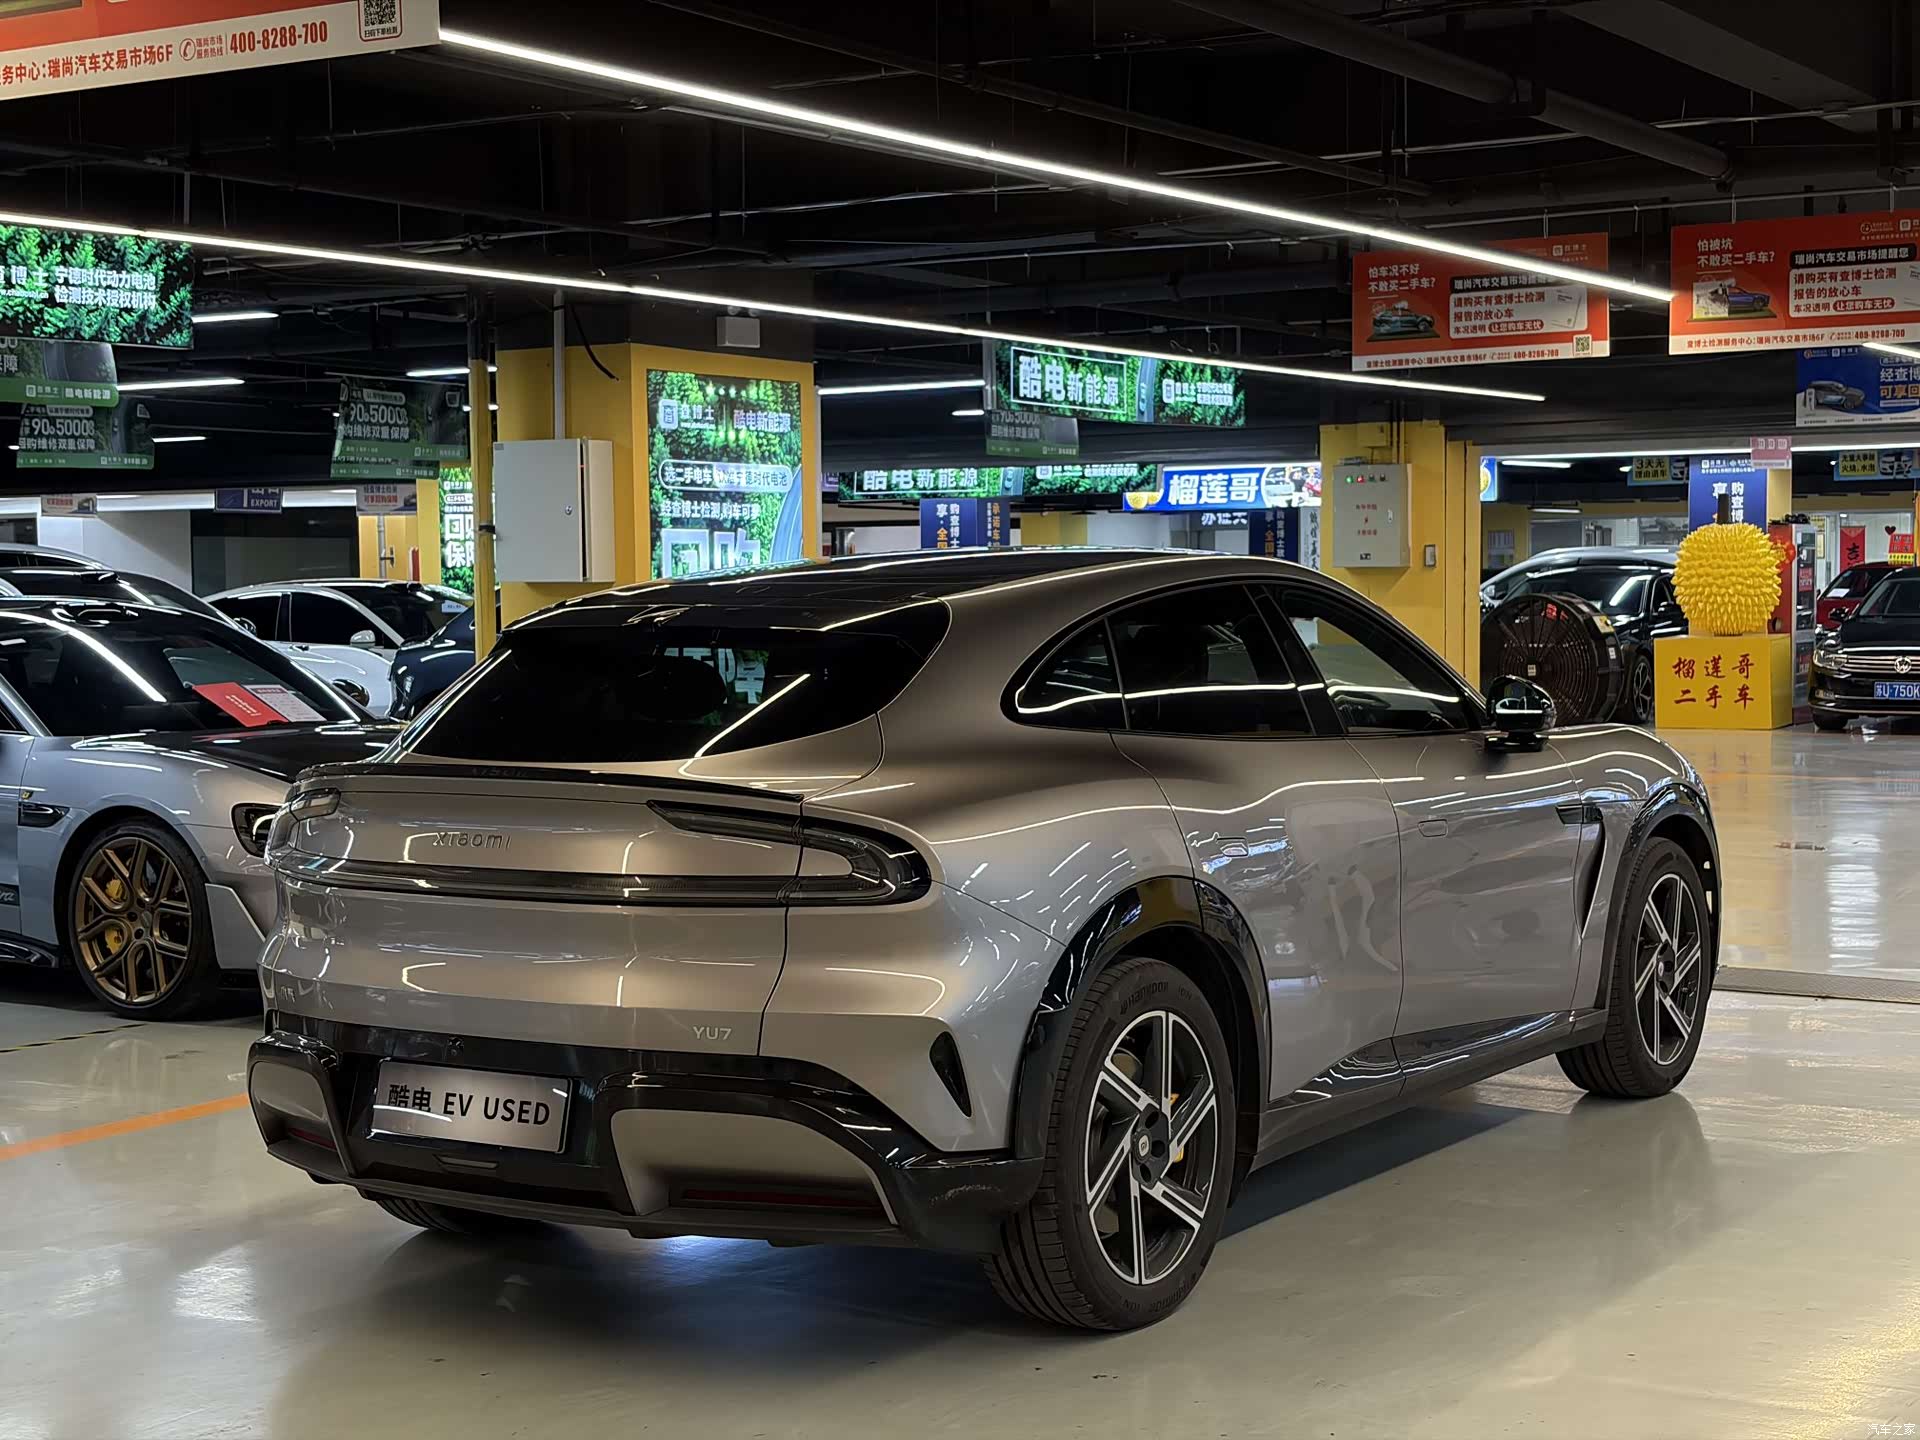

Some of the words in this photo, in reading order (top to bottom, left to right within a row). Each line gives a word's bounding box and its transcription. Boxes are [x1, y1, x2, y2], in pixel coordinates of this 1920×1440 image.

[230, 20, 329, 54] 400-8288-700
[0, 46, 173, 86] 务中心:瑞尚汽车交易市场6F
[55, 266, 156, 290] 宁德时代动力电池
[1794, 267, 1897, 285] 请购买有查博士检测
[54, 285, 157, 310] 检测技术授权机构
[1794, 285, 1863, 300] 报告的放心车
[1018, 355, 1120, 406] 酷电新能源
[733, 408, 792, 433] 酷电新能源
[862, 466, 979, 491] 酷电新能源
[1168, 473, 1260, 505] 榴莲哥
[1674, 684, 1755, 709] 二手车
[432, 831, 512, 849] xiaomi
[692, 1026, 733, 1040] YU7
[388, 1084, 432, 1113] 酷电
[443, 1093, 473, 1117] EV
[483, 1096, 551, 1126] USED
